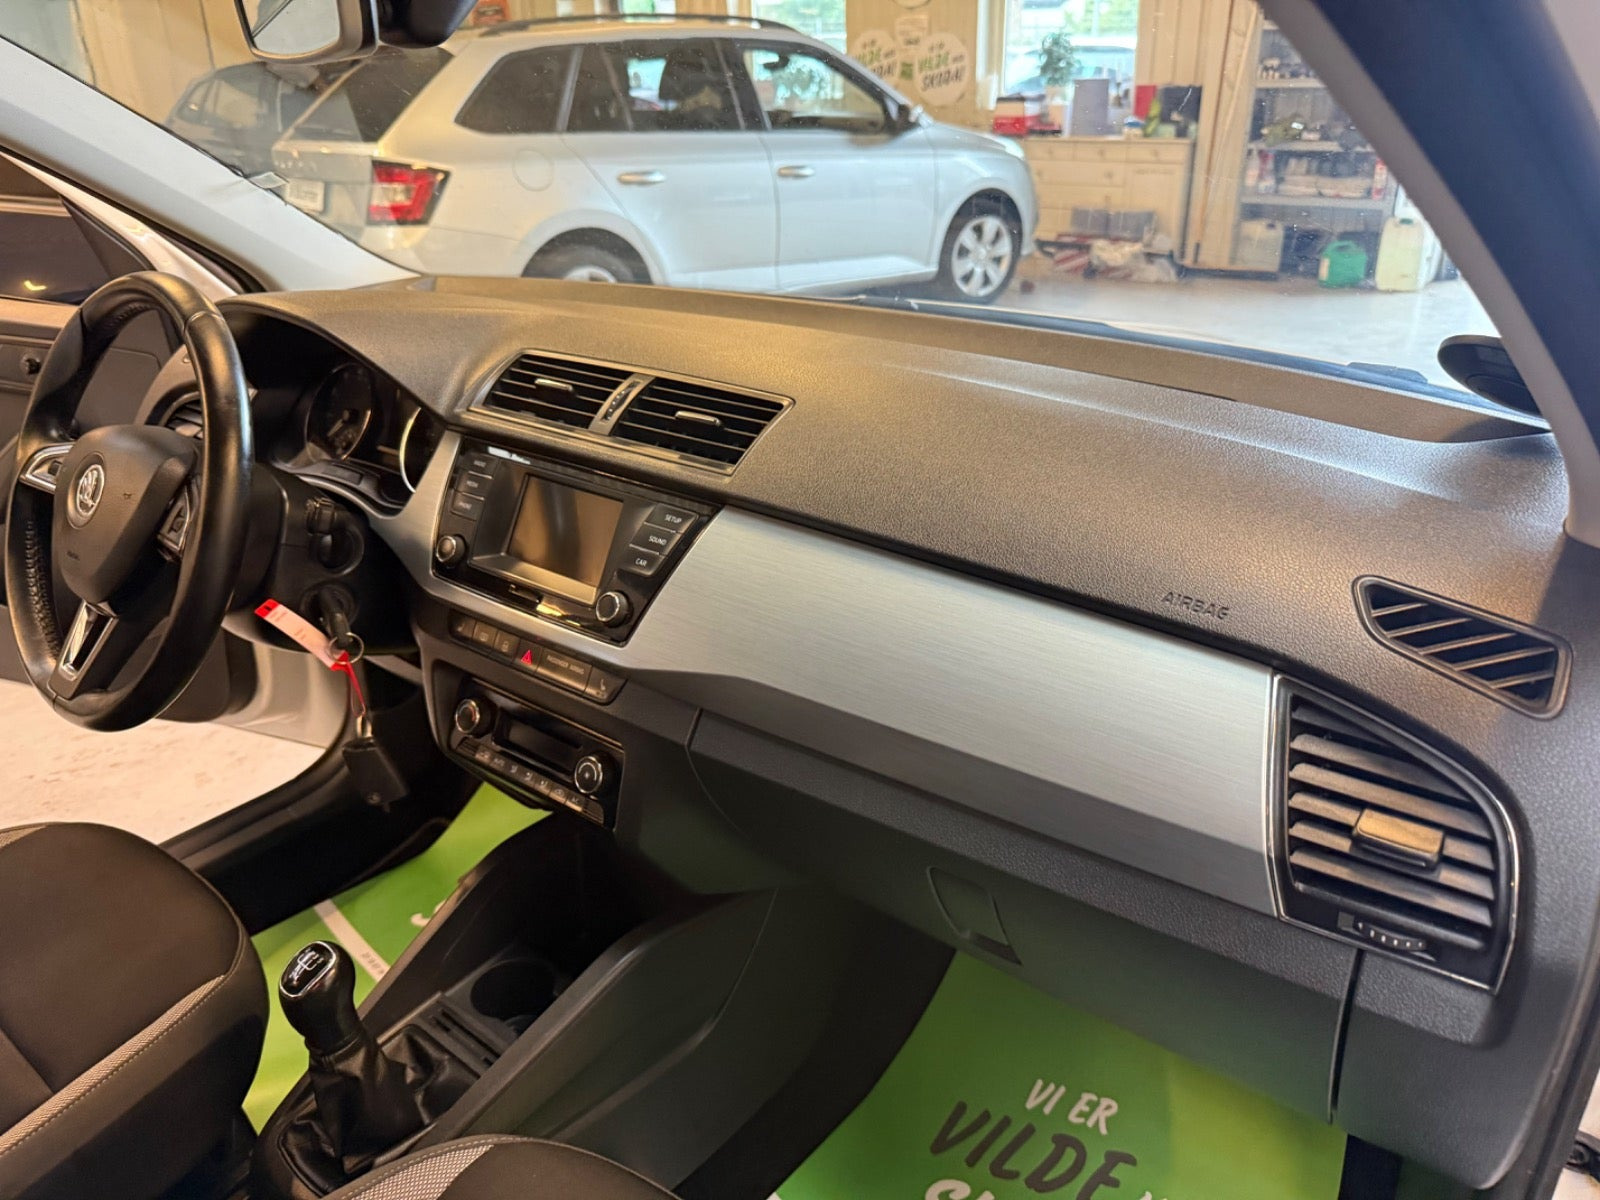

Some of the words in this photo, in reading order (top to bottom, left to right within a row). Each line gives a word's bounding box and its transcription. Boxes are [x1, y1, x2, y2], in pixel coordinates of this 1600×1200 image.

[665, 513, 682, 524] SETUP
[648, 535, 667, 546] SOUND
[635, 558, 648, 567] CAR
[1161, 591, 1230, 620] AIRBAG
[1024, 1078, 1067, 1116] VI
[1068, 1092, 1119, 1136] ER
[929, 1100, 1139, 1200] VILDE
